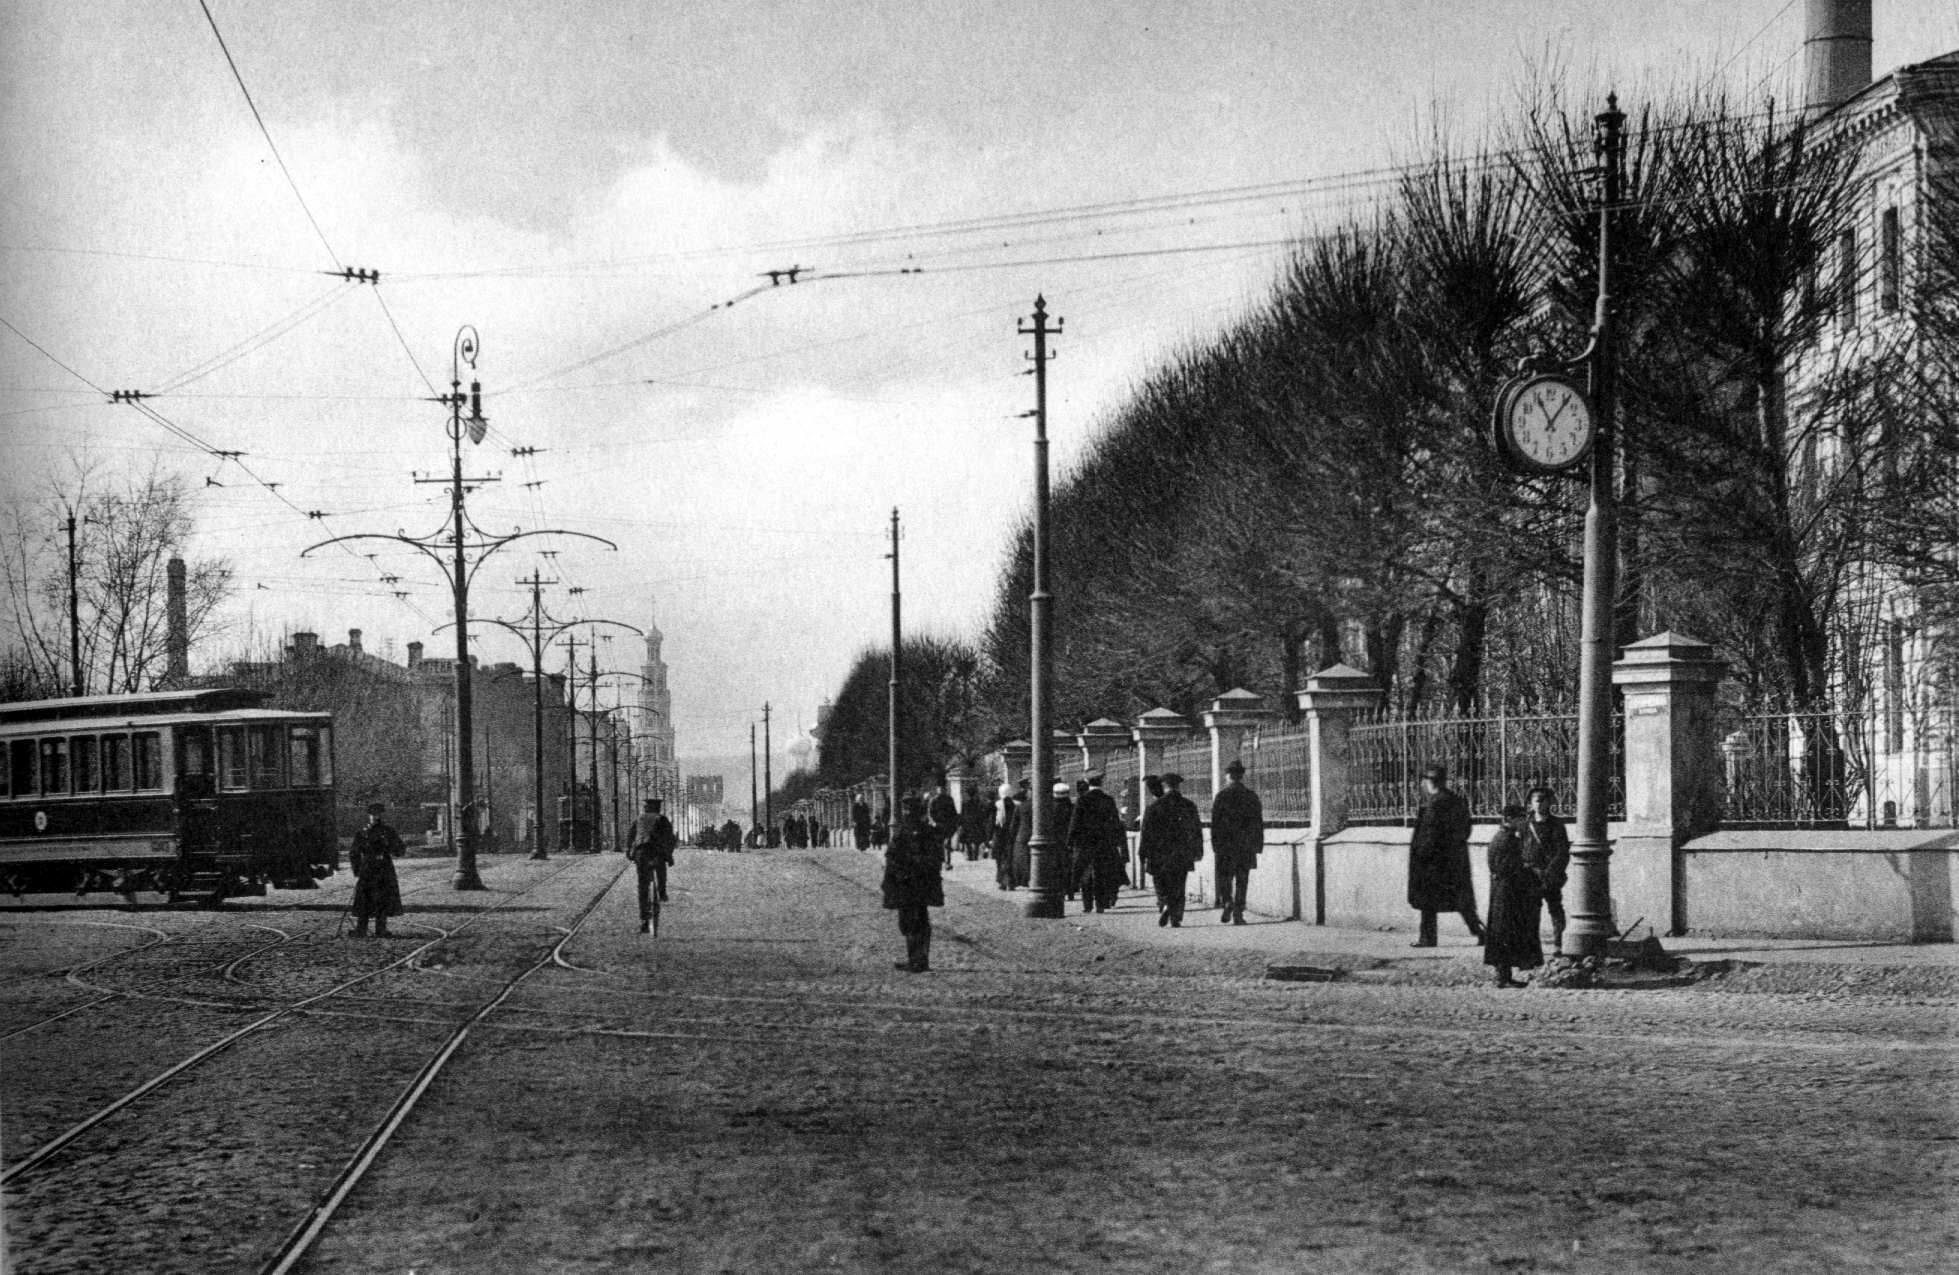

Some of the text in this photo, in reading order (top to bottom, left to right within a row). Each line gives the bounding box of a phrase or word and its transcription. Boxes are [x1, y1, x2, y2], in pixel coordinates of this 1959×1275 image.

[1546, 389, 1556, 401] 12
[1523, 402, 1533, 415] 10
[1570, 403, 1578, 417] 2
[1575, 418, 1582, 431] 3
[1532, 441, 1538, 455] 7
[1546, 446, 1554, 461] 6
[1560, 442, 1568, 455] 5
